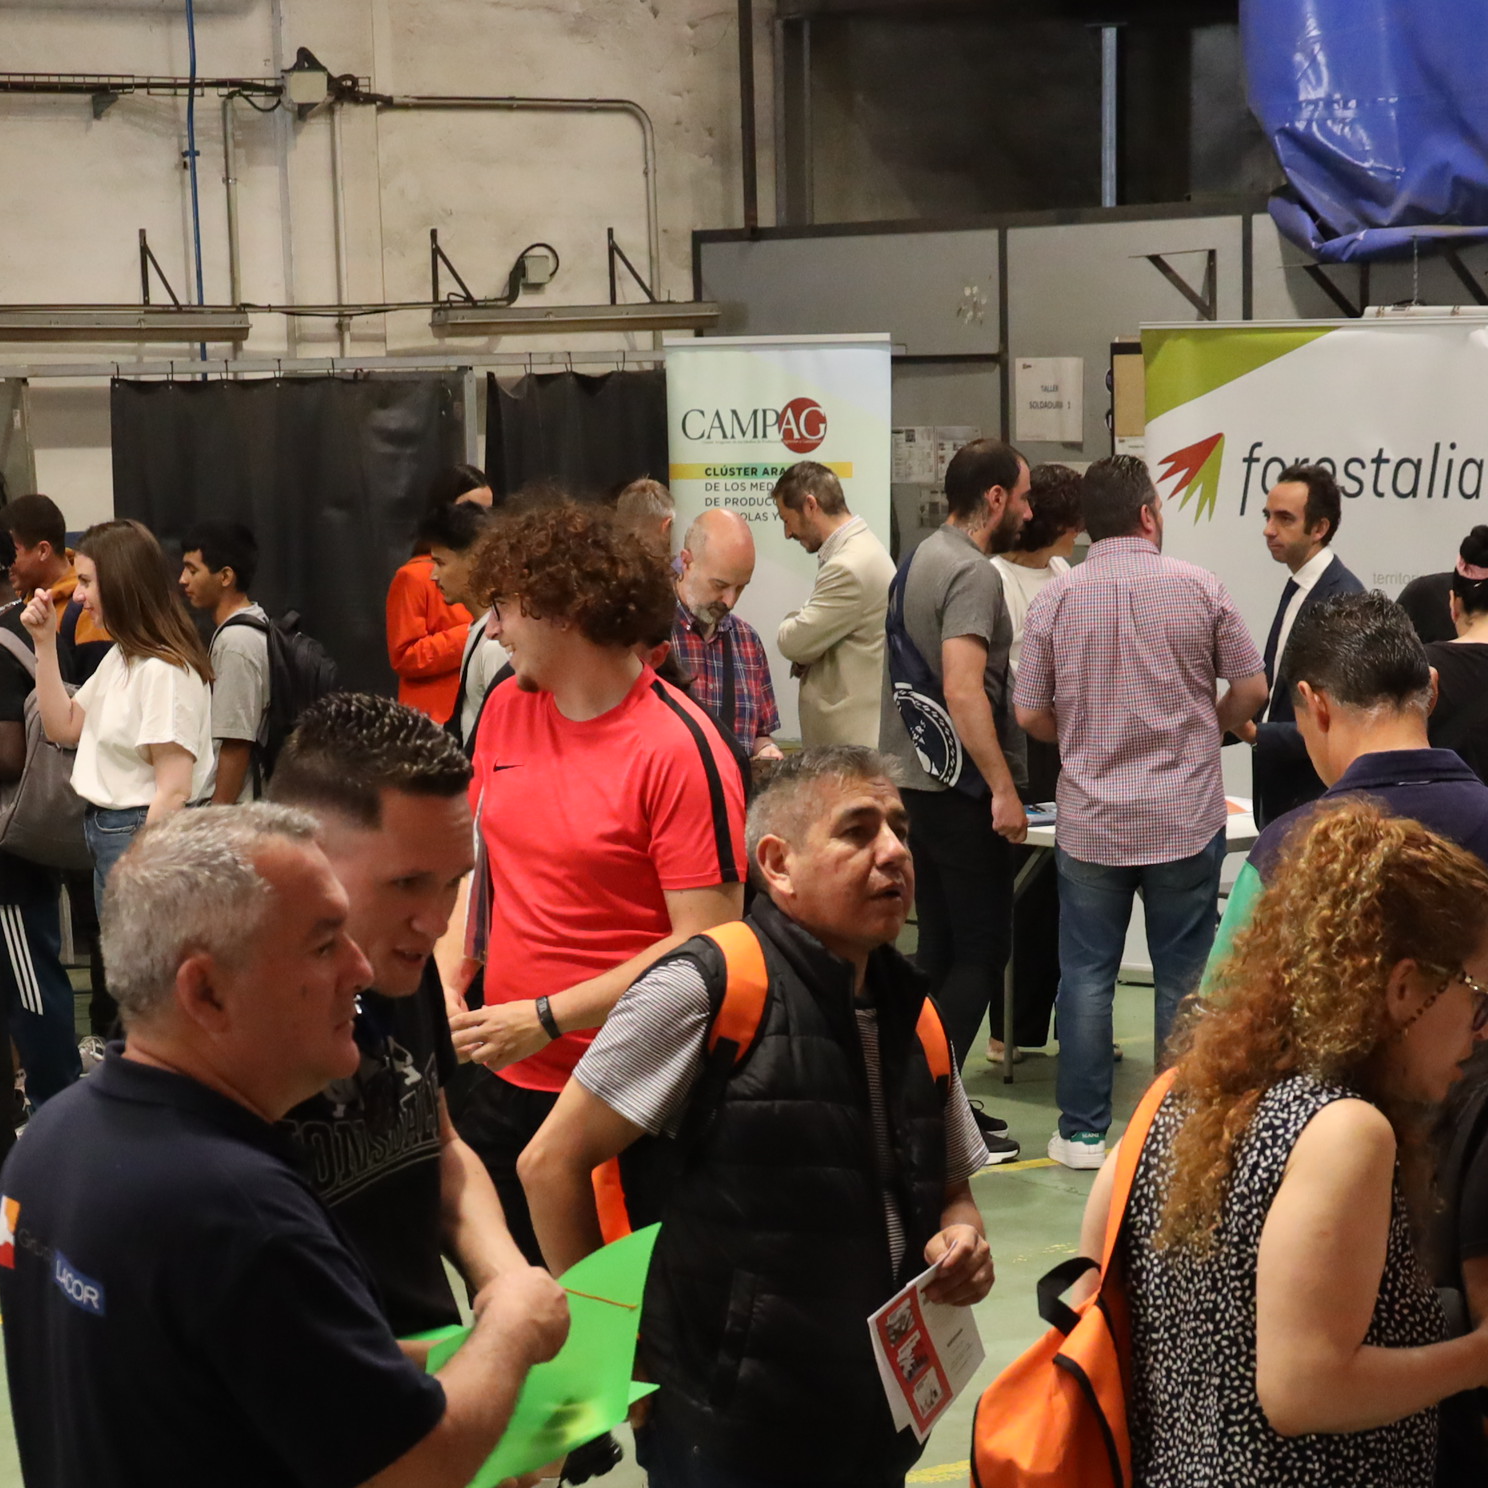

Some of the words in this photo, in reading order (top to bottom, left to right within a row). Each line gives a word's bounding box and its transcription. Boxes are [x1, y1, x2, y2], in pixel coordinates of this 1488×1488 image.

[681, 406, 827, 441] CAMPAG
[704, 464, 758, 477] CLÚSTER
[704, 482, 720, 492] DE
[724, 482, 746, 492] LOS
[704, 497, 720, 507] DE
[772, 513, 780, 521] Y
[55, 1259, 100, 1310] LACOR
